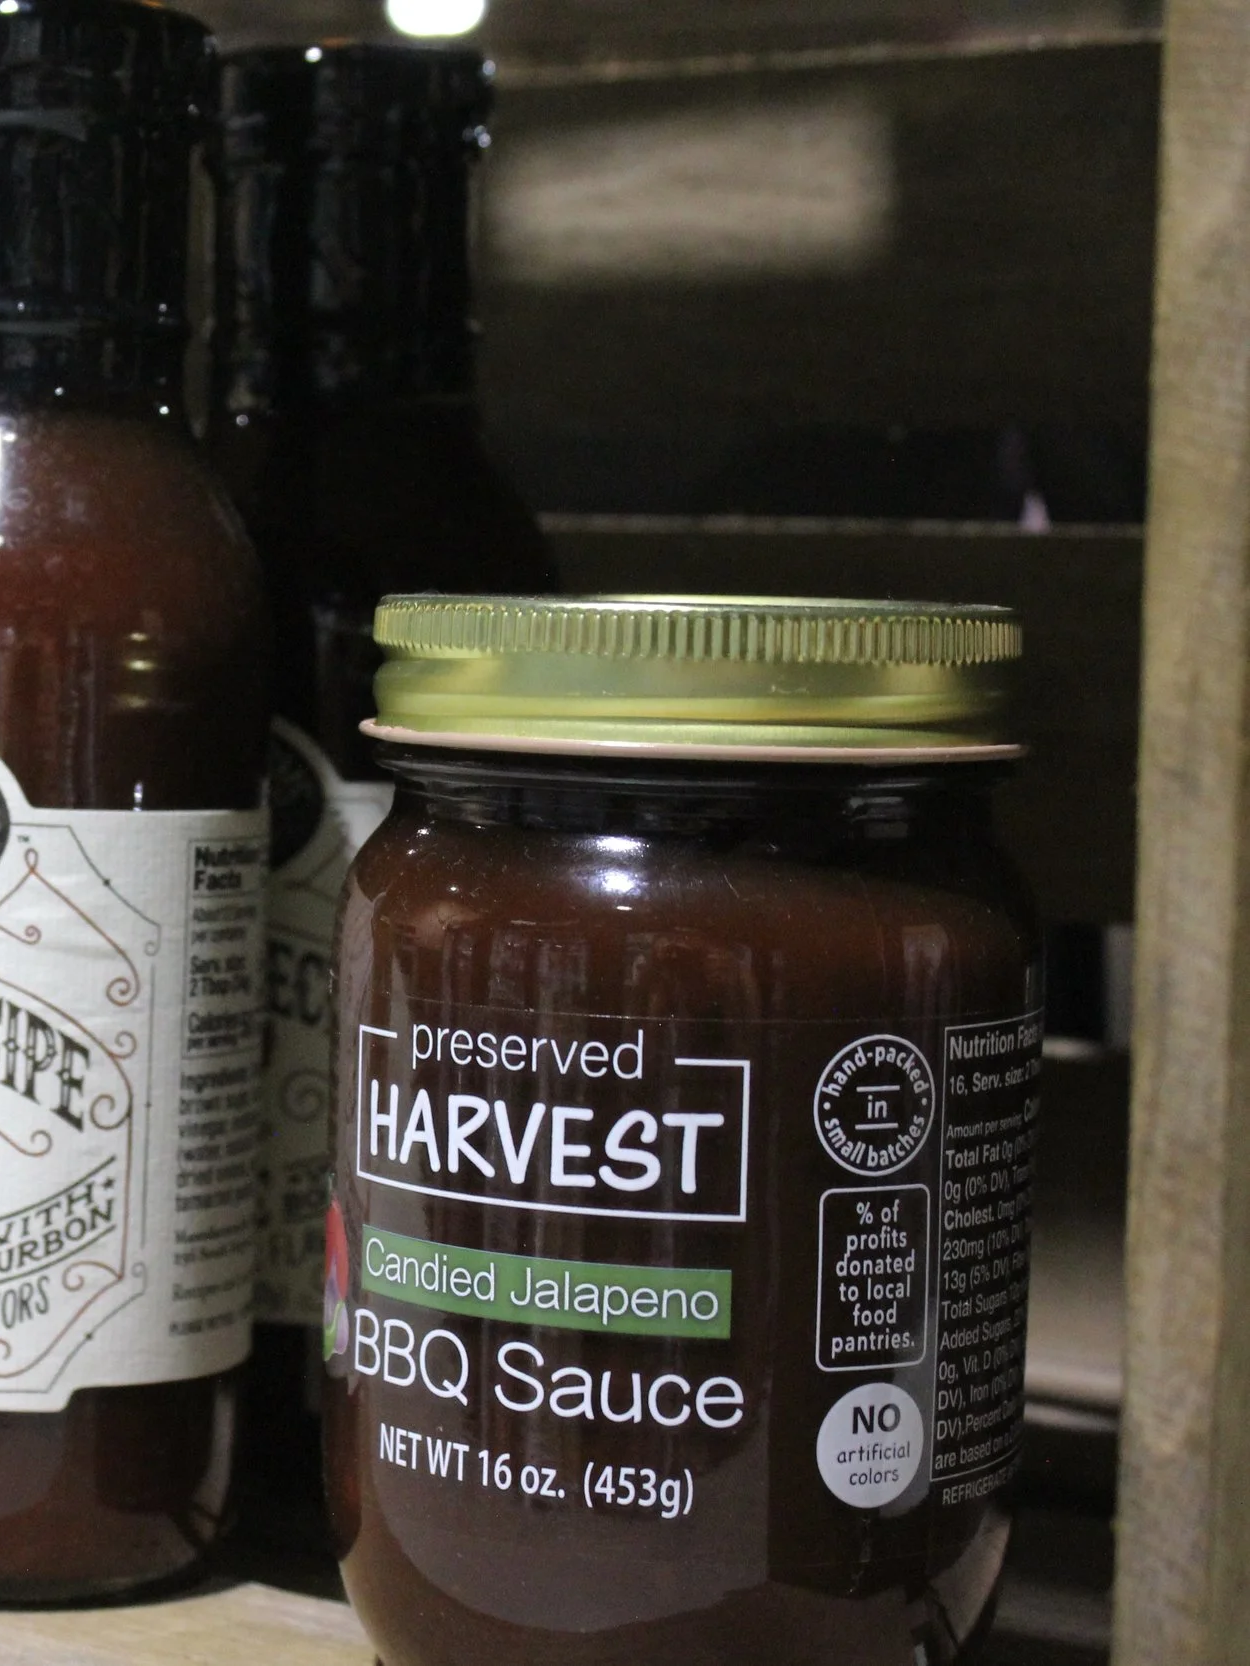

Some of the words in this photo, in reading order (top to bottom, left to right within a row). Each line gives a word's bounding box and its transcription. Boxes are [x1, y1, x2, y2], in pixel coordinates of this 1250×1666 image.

[412, 1023, 644, 1079] preserved
[950, 1030, 1014, 1061] Nutrition
[822, 1045, 929, 1097] hand-packed
[972, 1071, 1002, 1093] Serv.
[867, 1094, 887, 1118] in
[370, 1079, 725, 1193] HARVEST
[824, 1117, 866, 1164] small
[867, 1115, 925, 1167] batches
[946, 1121, 982, 1139] Amount
[945, 1145, 979, 1170] Total
[982, 1144, 999, 1164] Fat
[944, 1180, 961, 1204] 0g
[964, 1174, 987, 1200] (0%
[856, 1201, 874, 1225] %
[880, 1199, 900, 1224] of
[944, 1203, 995, 1231] Cholest.
[846, 1226, 908, 1257] profits
[942, 1238, 984, 1261] 230mg
[836, 1249, 916, 1277] donated
[364, 1236, 496, 1302] Candied
[510, 1266, 720, 1325] Jalapeno
[839, 1281, 859, 1302] to
[866, 1275, 911, 1300] local
[943, 1270, 966, 1293] 13g
[852, 1301, 897, 1327] food
[941, 1298, 972, 1320] Total
[975, 1290, 1007, 1315] Sugars
[831, 1329, 915, 1359] pantries.
[939, 1324, 979, 1351] Added
[982, 1317, 1012, 1342] Sugars
[354, 1307, 469, 1407] BBQ
[494, 1340, 745, 1429] Sauce
[983, 1350, 992, 1370] D
[969, 1383, 989, 1404] Iron
[851, 1403, 902, 1435] NO
[836, 1440, 911, 1464] artificial
[934, 1451, 957, 1470] are
[959, 1441, 992, 1464] based
[379, 1422, 422, 1471] NET
[425, 1440, 470, 1481] WT
[478, 1448, 513, 1491] 16
[520, 1462, 566, 1499] oz.
[583, 1460, 695, 1519] (453g)
[849, 1467, 900, 1487] colors
